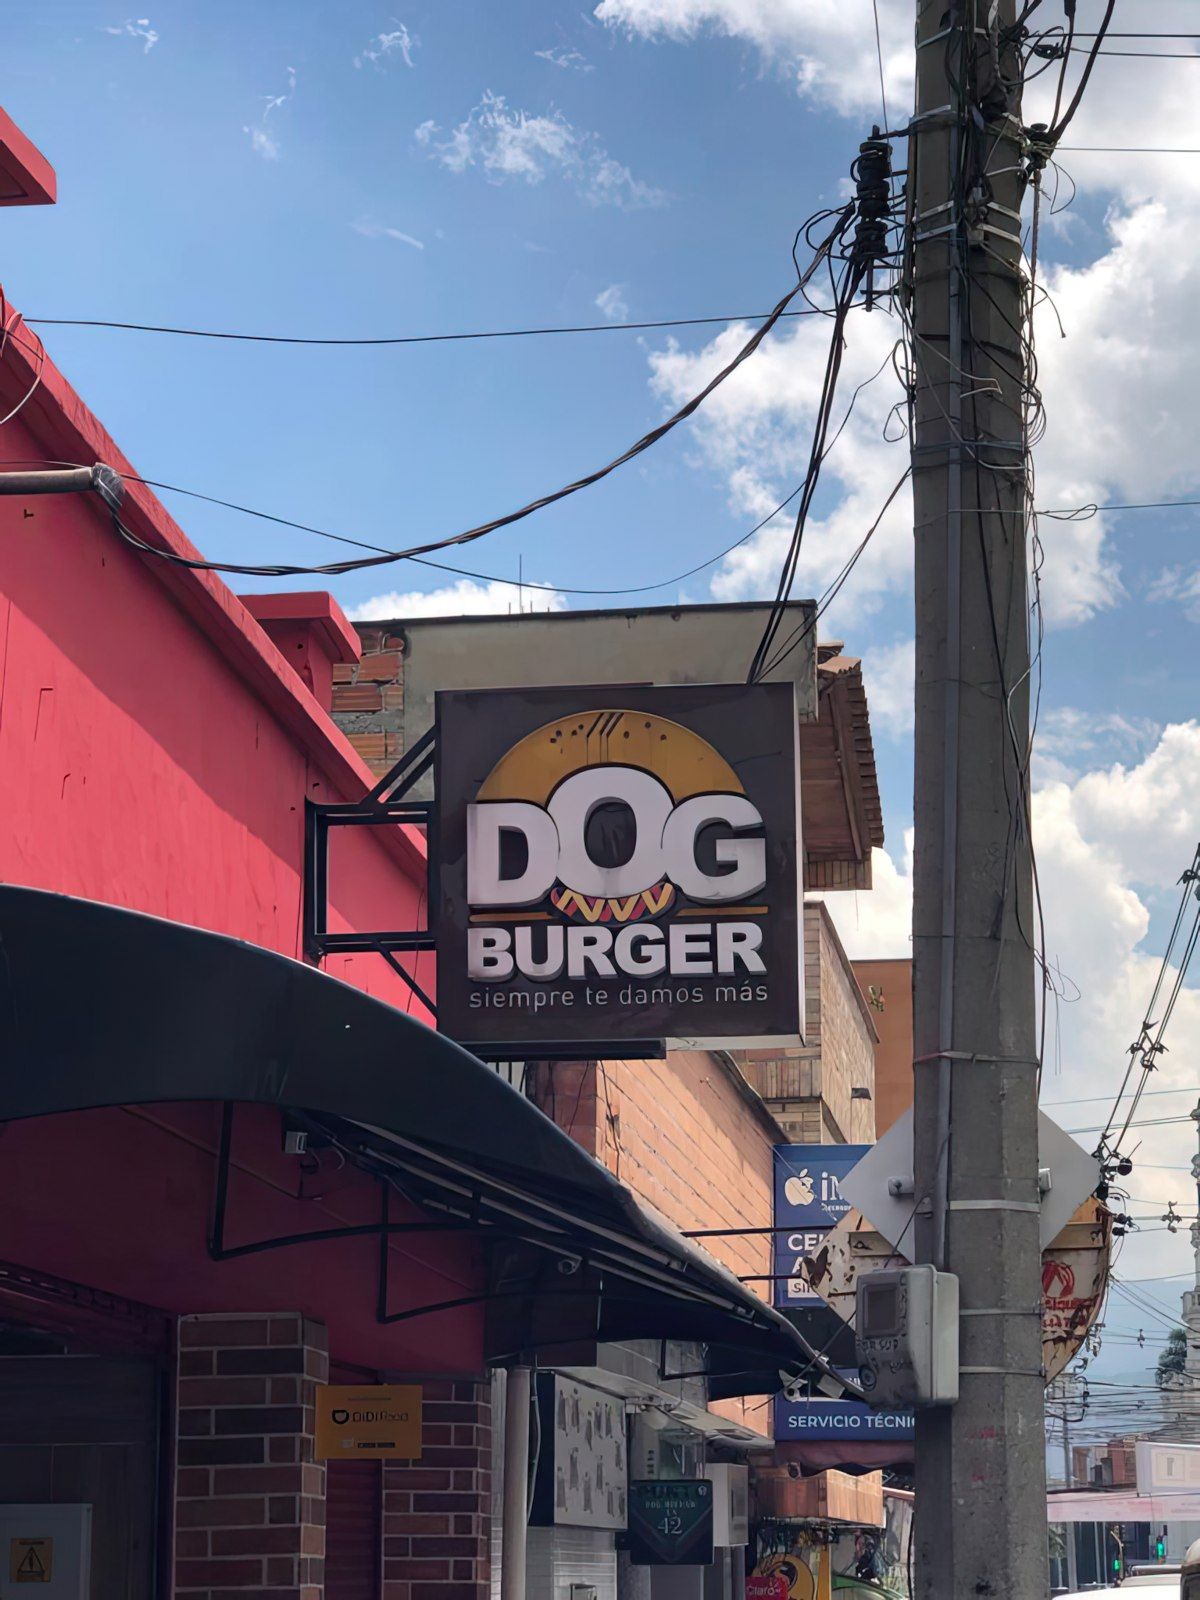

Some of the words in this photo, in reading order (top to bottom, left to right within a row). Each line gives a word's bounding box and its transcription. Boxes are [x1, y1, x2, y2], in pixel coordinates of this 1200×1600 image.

[467, 765, 767, 906] DOG
[467, 921, 768, 981] BURGER
[469, 984, 574, 1012] siempre
[586, 985, 609, 1006] te
[619, 982, 704, 1005] damos
[715, 979, 768, 1001] más
[788, 1415, 861, 1428] SERVICIO
